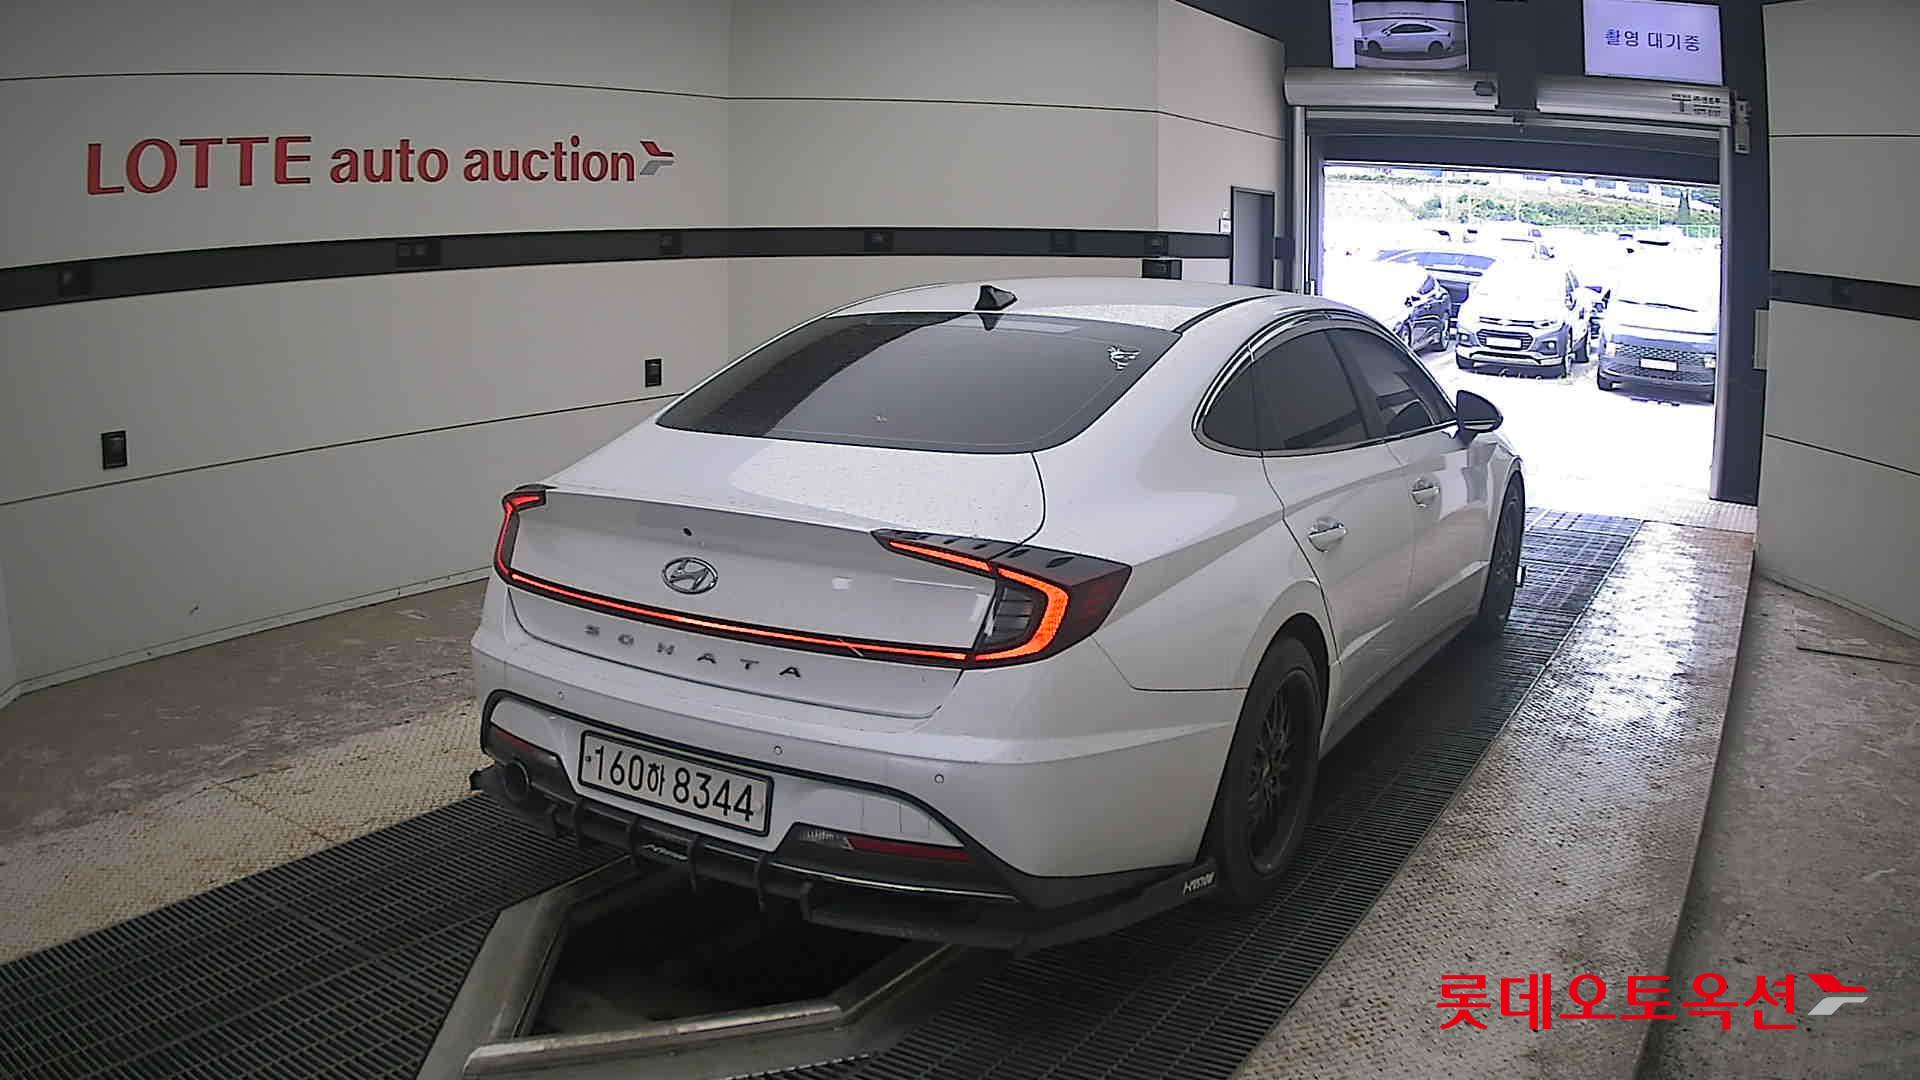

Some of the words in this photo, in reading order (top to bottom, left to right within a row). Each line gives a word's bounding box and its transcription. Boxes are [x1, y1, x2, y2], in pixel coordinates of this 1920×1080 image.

[1647, 32, 1700, 52] 대기중
[88, 136, 311, 195] LOTTE
[329, 138, 449, 183] auto
[463, 136, 636, 182] auction
[585, 625, 801, 678] SONATA
[672, 767, 754, 822] 8344
